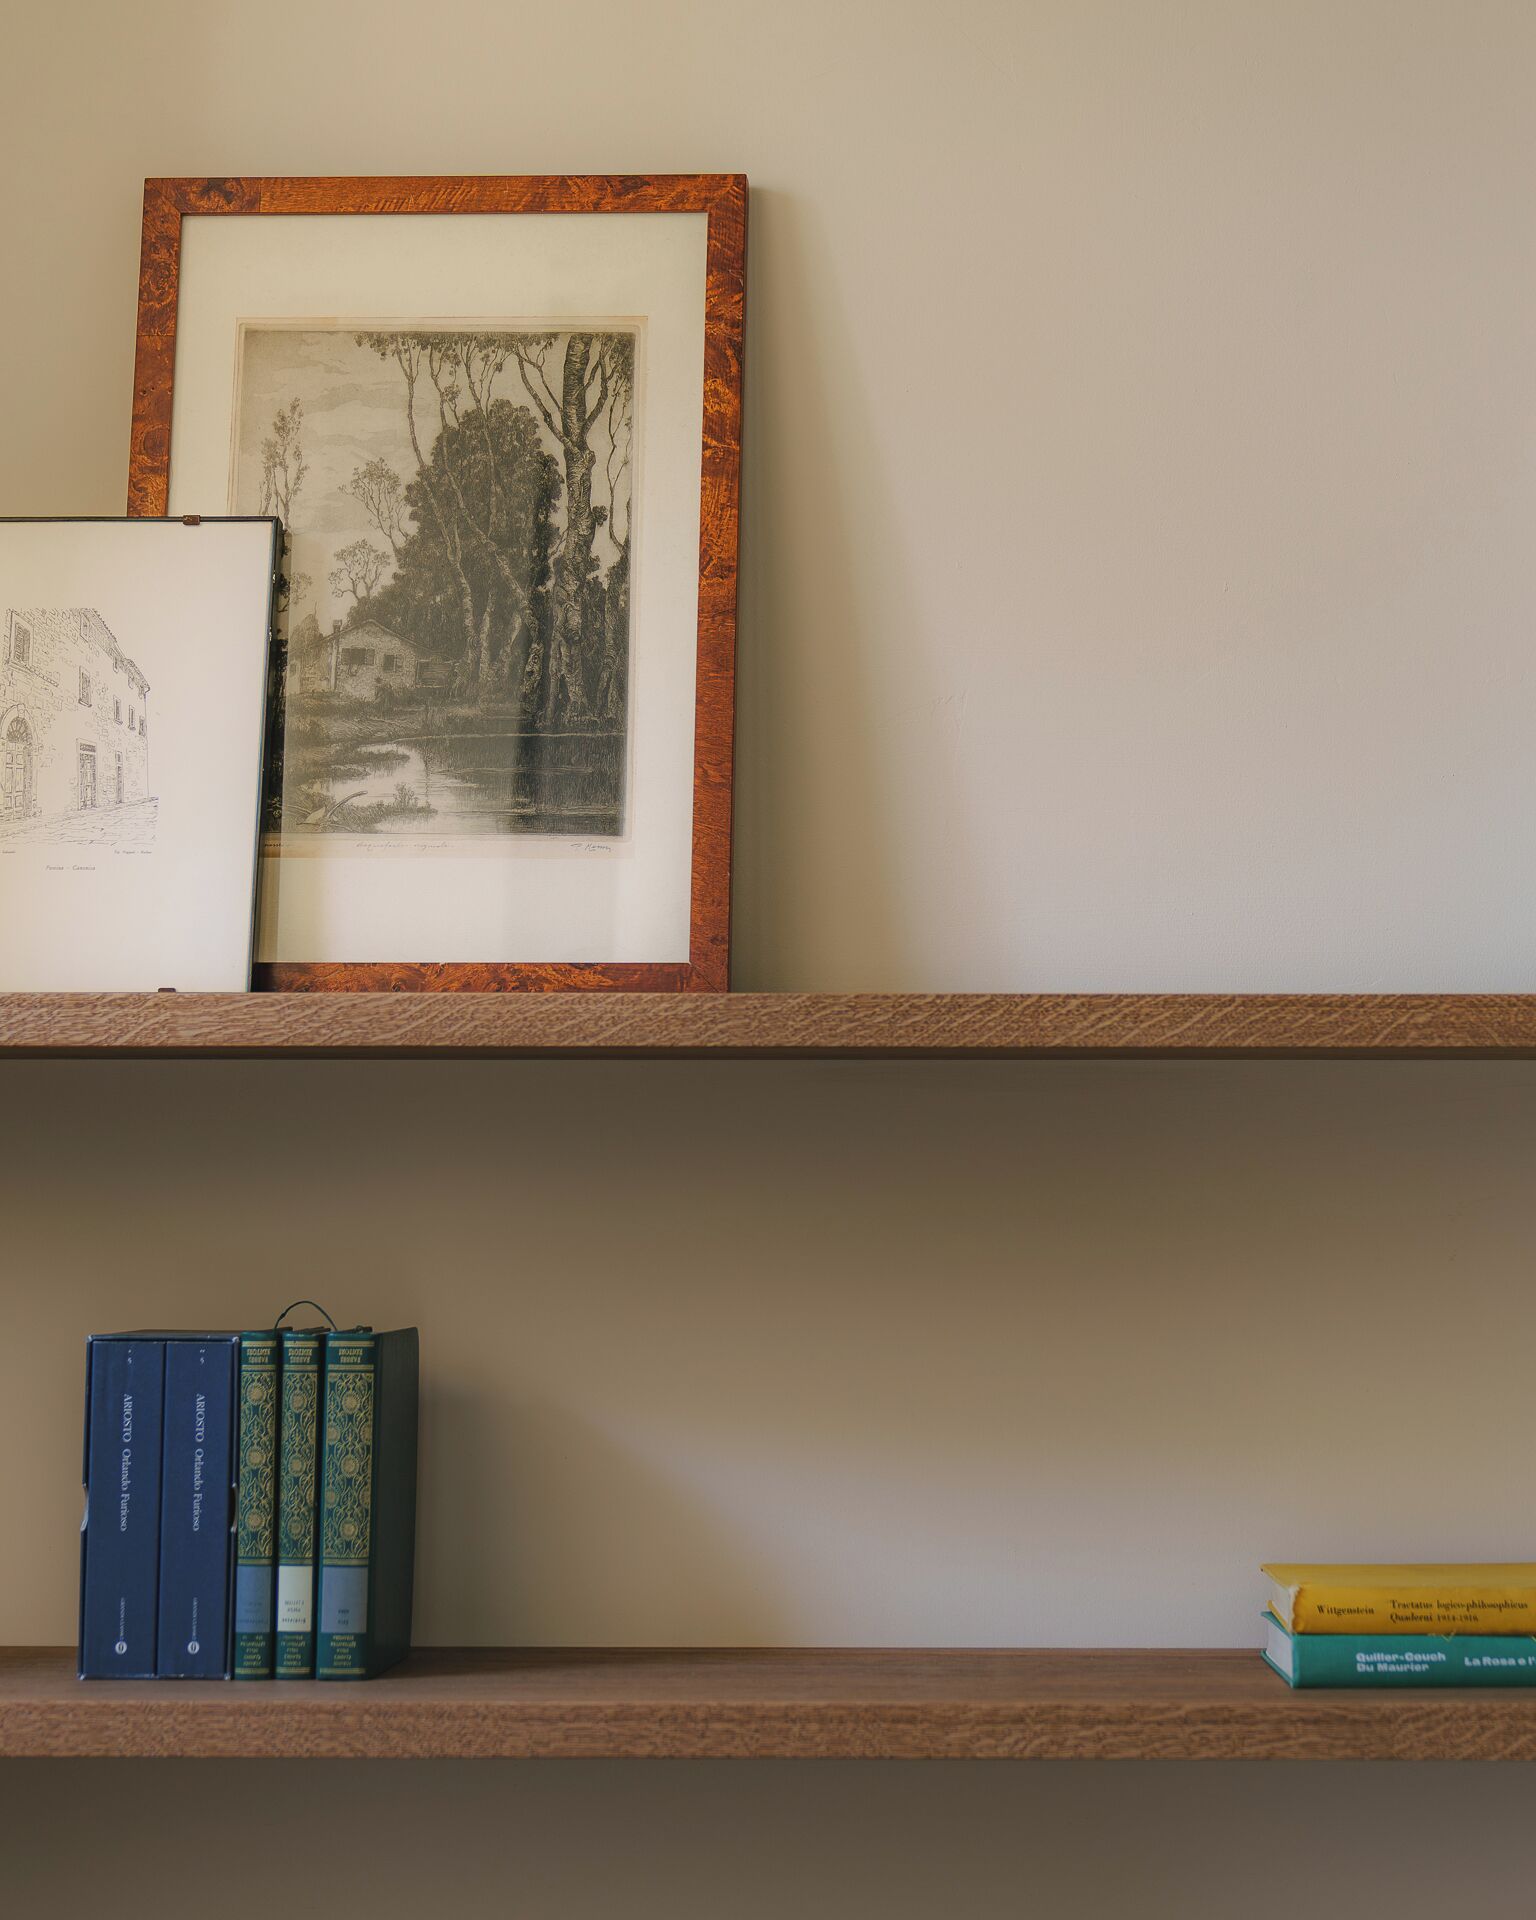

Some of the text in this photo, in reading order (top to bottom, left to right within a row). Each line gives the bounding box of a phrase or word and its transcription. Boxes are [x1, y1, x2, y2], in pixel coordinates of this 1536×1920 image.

[119, 1393, 132, 1532] ARIOSTO Orlando Furioso
[192, 1393, 205, 1532] ARIOSTO Orlando Furioso
[1389, 1599, 1433, 1610] Tractatus
[1316, 1605, 1375, 1616] Wittgenstein
[1389, 1613, 1433, 1623] Quaderni
[1355, 1652, 1447, 1663] Quiller-Couch
[1464, 1657, 1482, 1667] La
[1482, 1657, 1516, 1667] Rosa
[1517, 1658, 1527, 1667] e
[1356, 1663, 1430, 1672] Du Maurier
